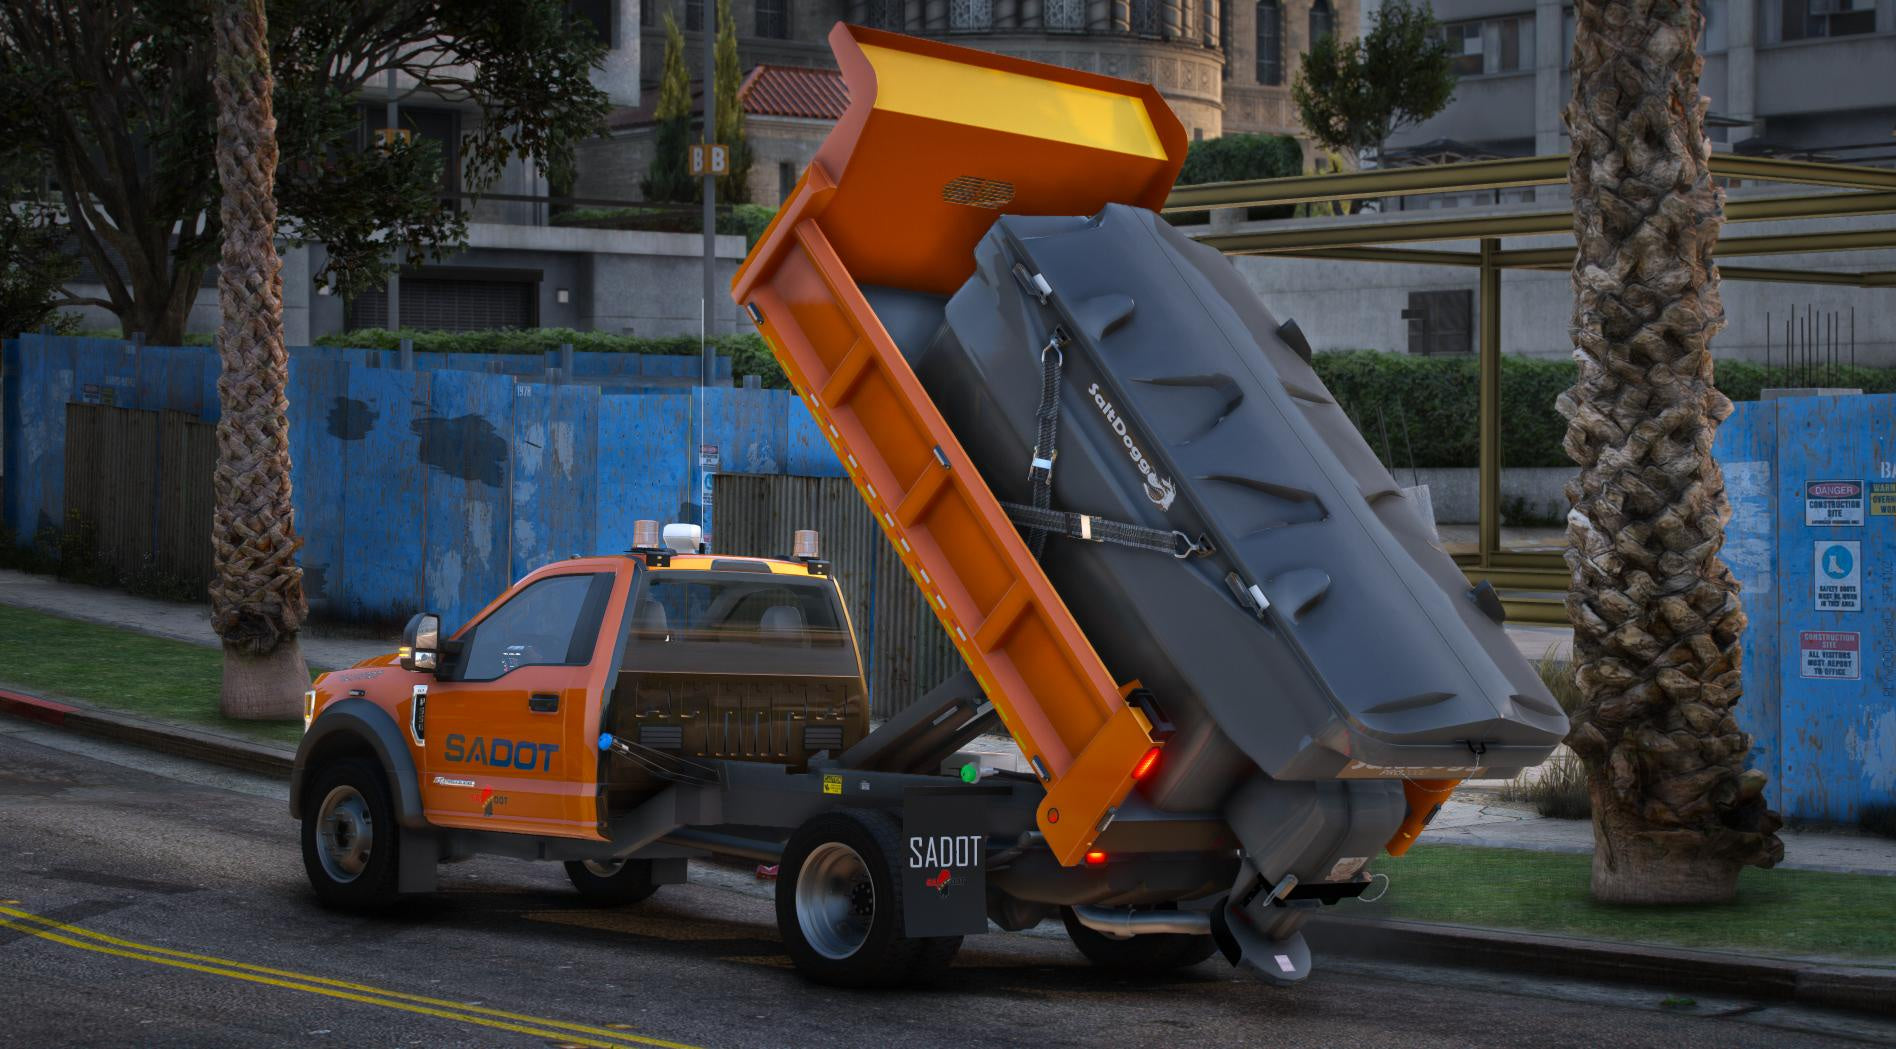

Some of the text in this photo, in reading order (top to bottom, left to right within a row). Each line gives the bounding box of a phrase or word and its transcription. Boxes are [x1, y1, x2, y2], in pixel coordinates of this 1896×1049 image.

[712, 147, 724, 171] B
[1815, 486, 1854, 495] DANGER
[1827, 509, 1843, 517] SITE
[1804, 633, 1855, 641] CONSTRUCTION
[1822, 651, 1851, 659] VISITORS
[1824, 668, 1846, 676] OFFICE
[444, 733, 561, 772] SADOT
[909, 835, 982, 868] SADOT
